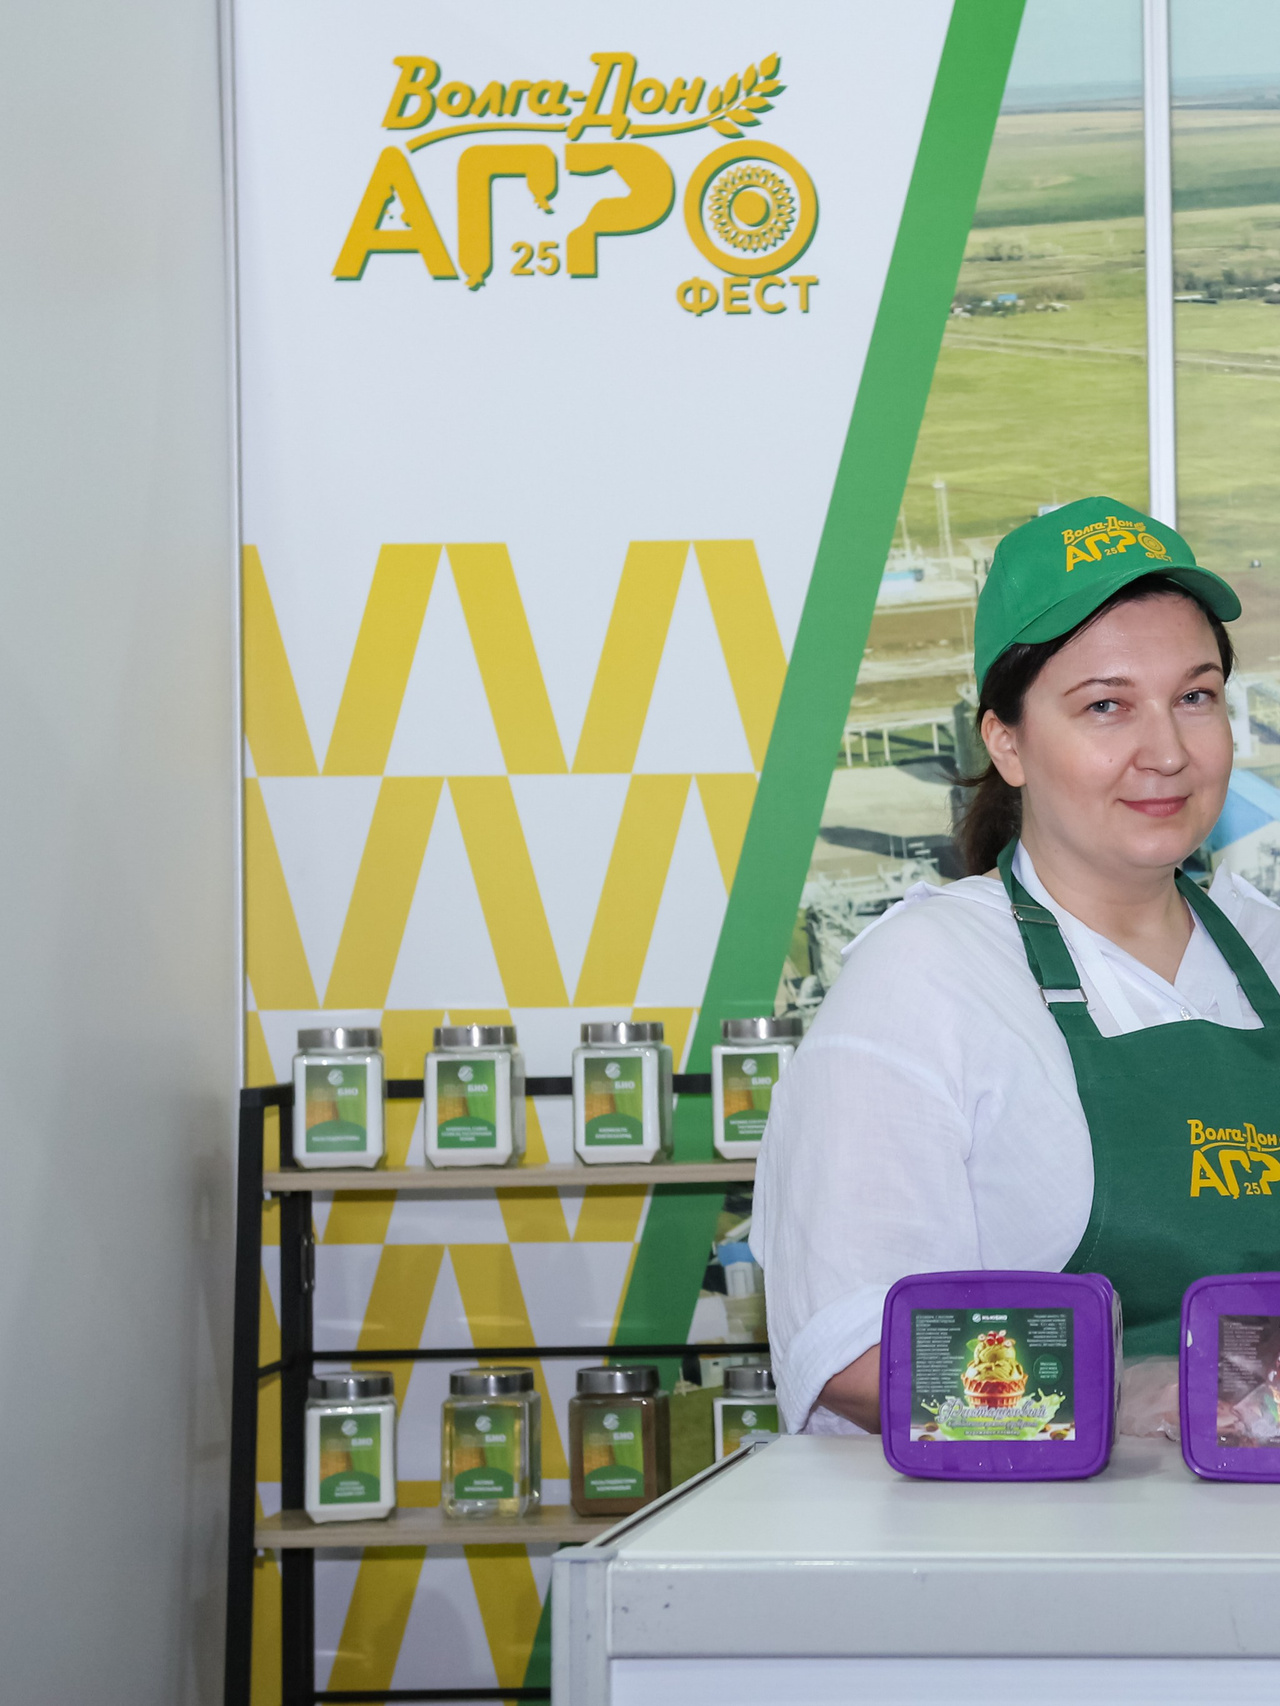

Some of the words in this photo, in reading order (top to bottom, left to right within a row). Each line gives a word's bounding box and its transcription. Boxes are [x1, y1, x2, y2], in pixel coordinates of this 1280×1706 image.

[381, 52, 706, 140] Волга-Дон
[331, 139, 819, 292] АГРО
[509, 241, 561, 276] 25
[675, 275, 820, 317] ФЕСТ
[1061, 516, 1133, 545] Волга-Дон
[1104, 547, 1118, 556] 25
[1187, 1119, 1277, 1151] Волга-Дон
[1243, 1182, 1261, 1195] 25
